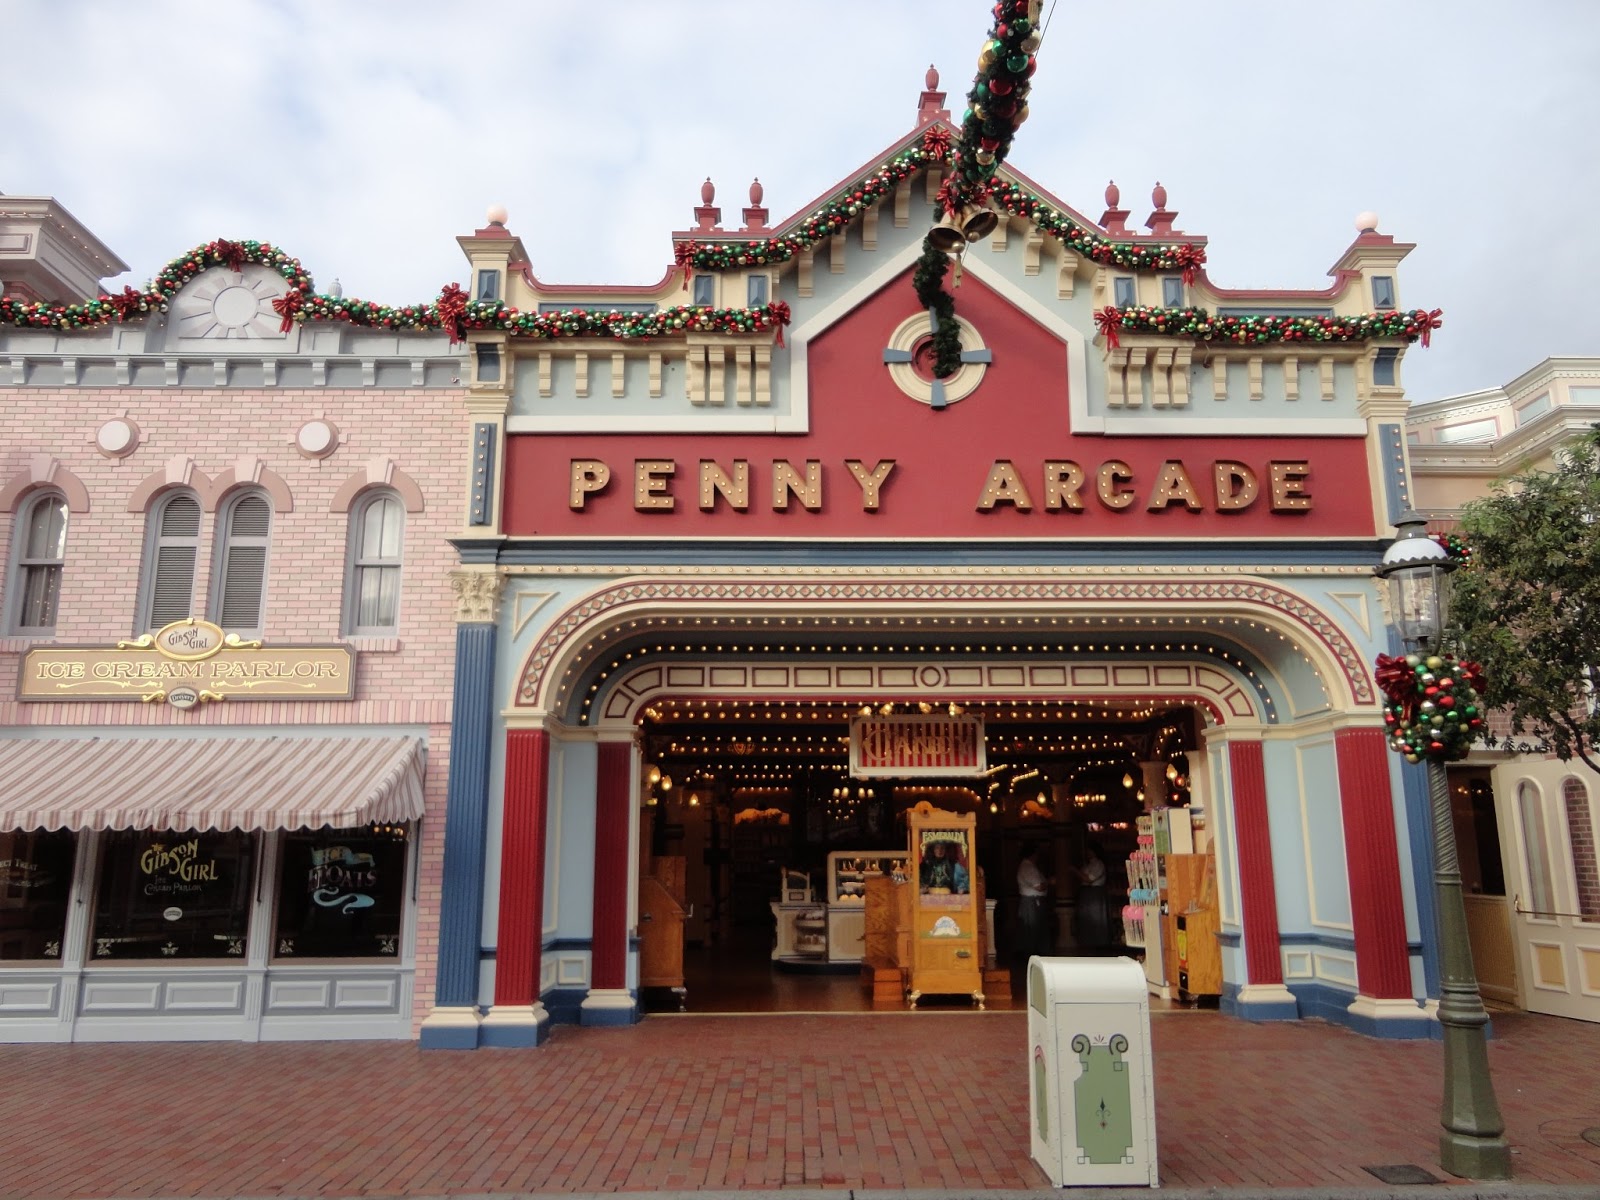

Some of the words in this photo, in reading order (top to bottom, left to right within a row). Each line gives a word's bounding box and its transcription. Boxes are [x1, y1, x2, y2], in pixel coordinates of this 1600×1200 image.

[569, 458, 896, 512] PENNY
[975, 459, 1312, 514] ARCADE
[168, 628, 198, 645] GIBSON
[189, 637, 209, 649] GIRL
[36, 662, 85, 679] ICE
[91, 661, 204, 679] CREAM
[210, 660, 341, 678] PARLOR
[923, 831, 965, 842] ESMERALDA
[141, 839, 198, 875] GIBSON
[180, 857, 219, 881] GIRL
